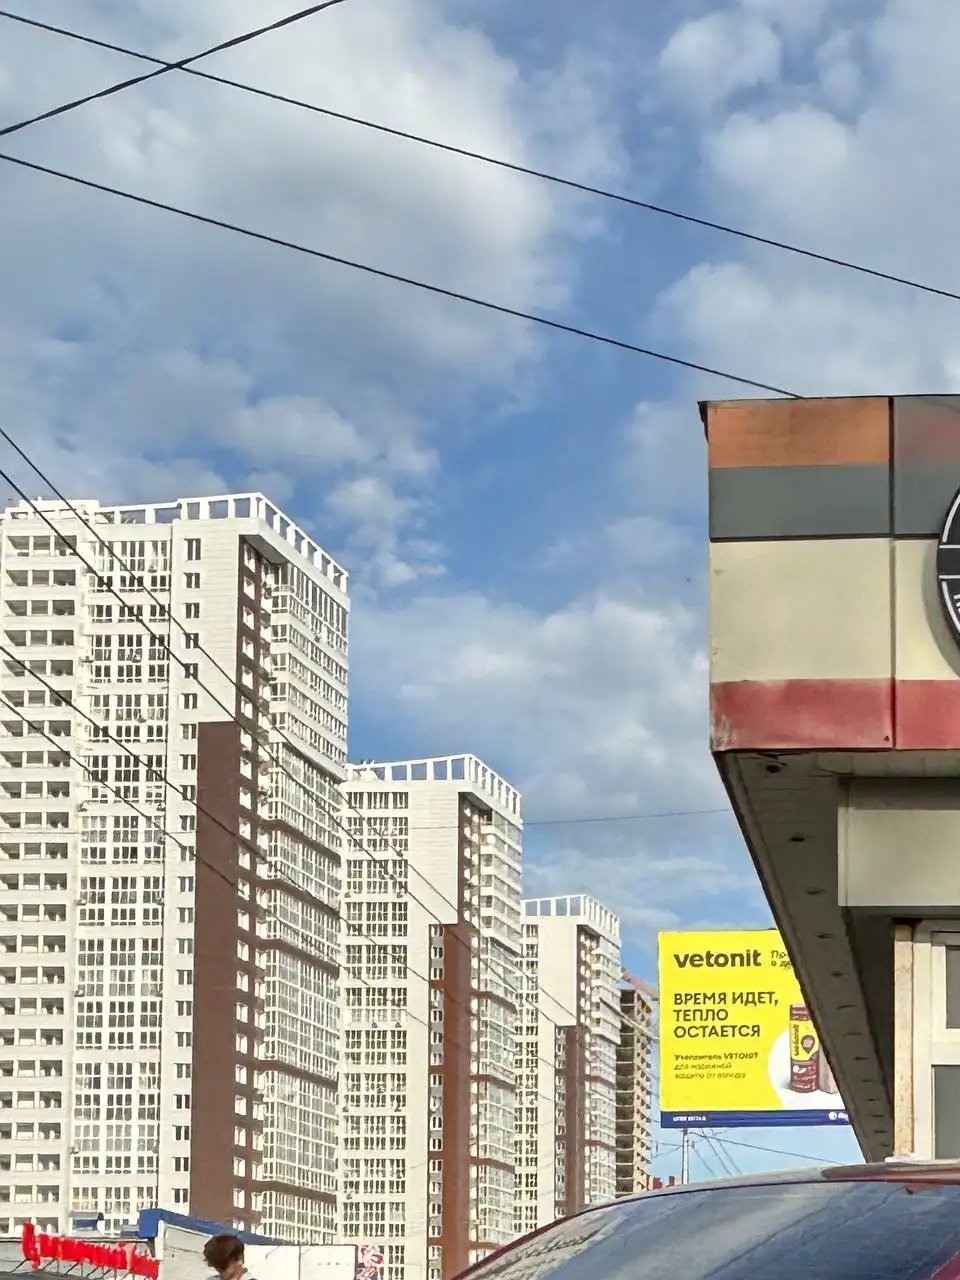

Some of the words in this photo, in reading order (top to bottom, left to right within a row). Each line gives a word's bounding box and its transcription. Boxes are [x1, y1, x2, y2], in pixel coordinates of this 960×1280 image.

[673, 949, 762, 969] vetonit
[673, 992, 727, 1006] ВРЕМЯ
[731, 991, 779, 1007] ИДЕТ,
[673, 1008, 729, 1022] ТЕПЛО
[673, 1024, 761, 1039] ОСТАЕТСЯ
